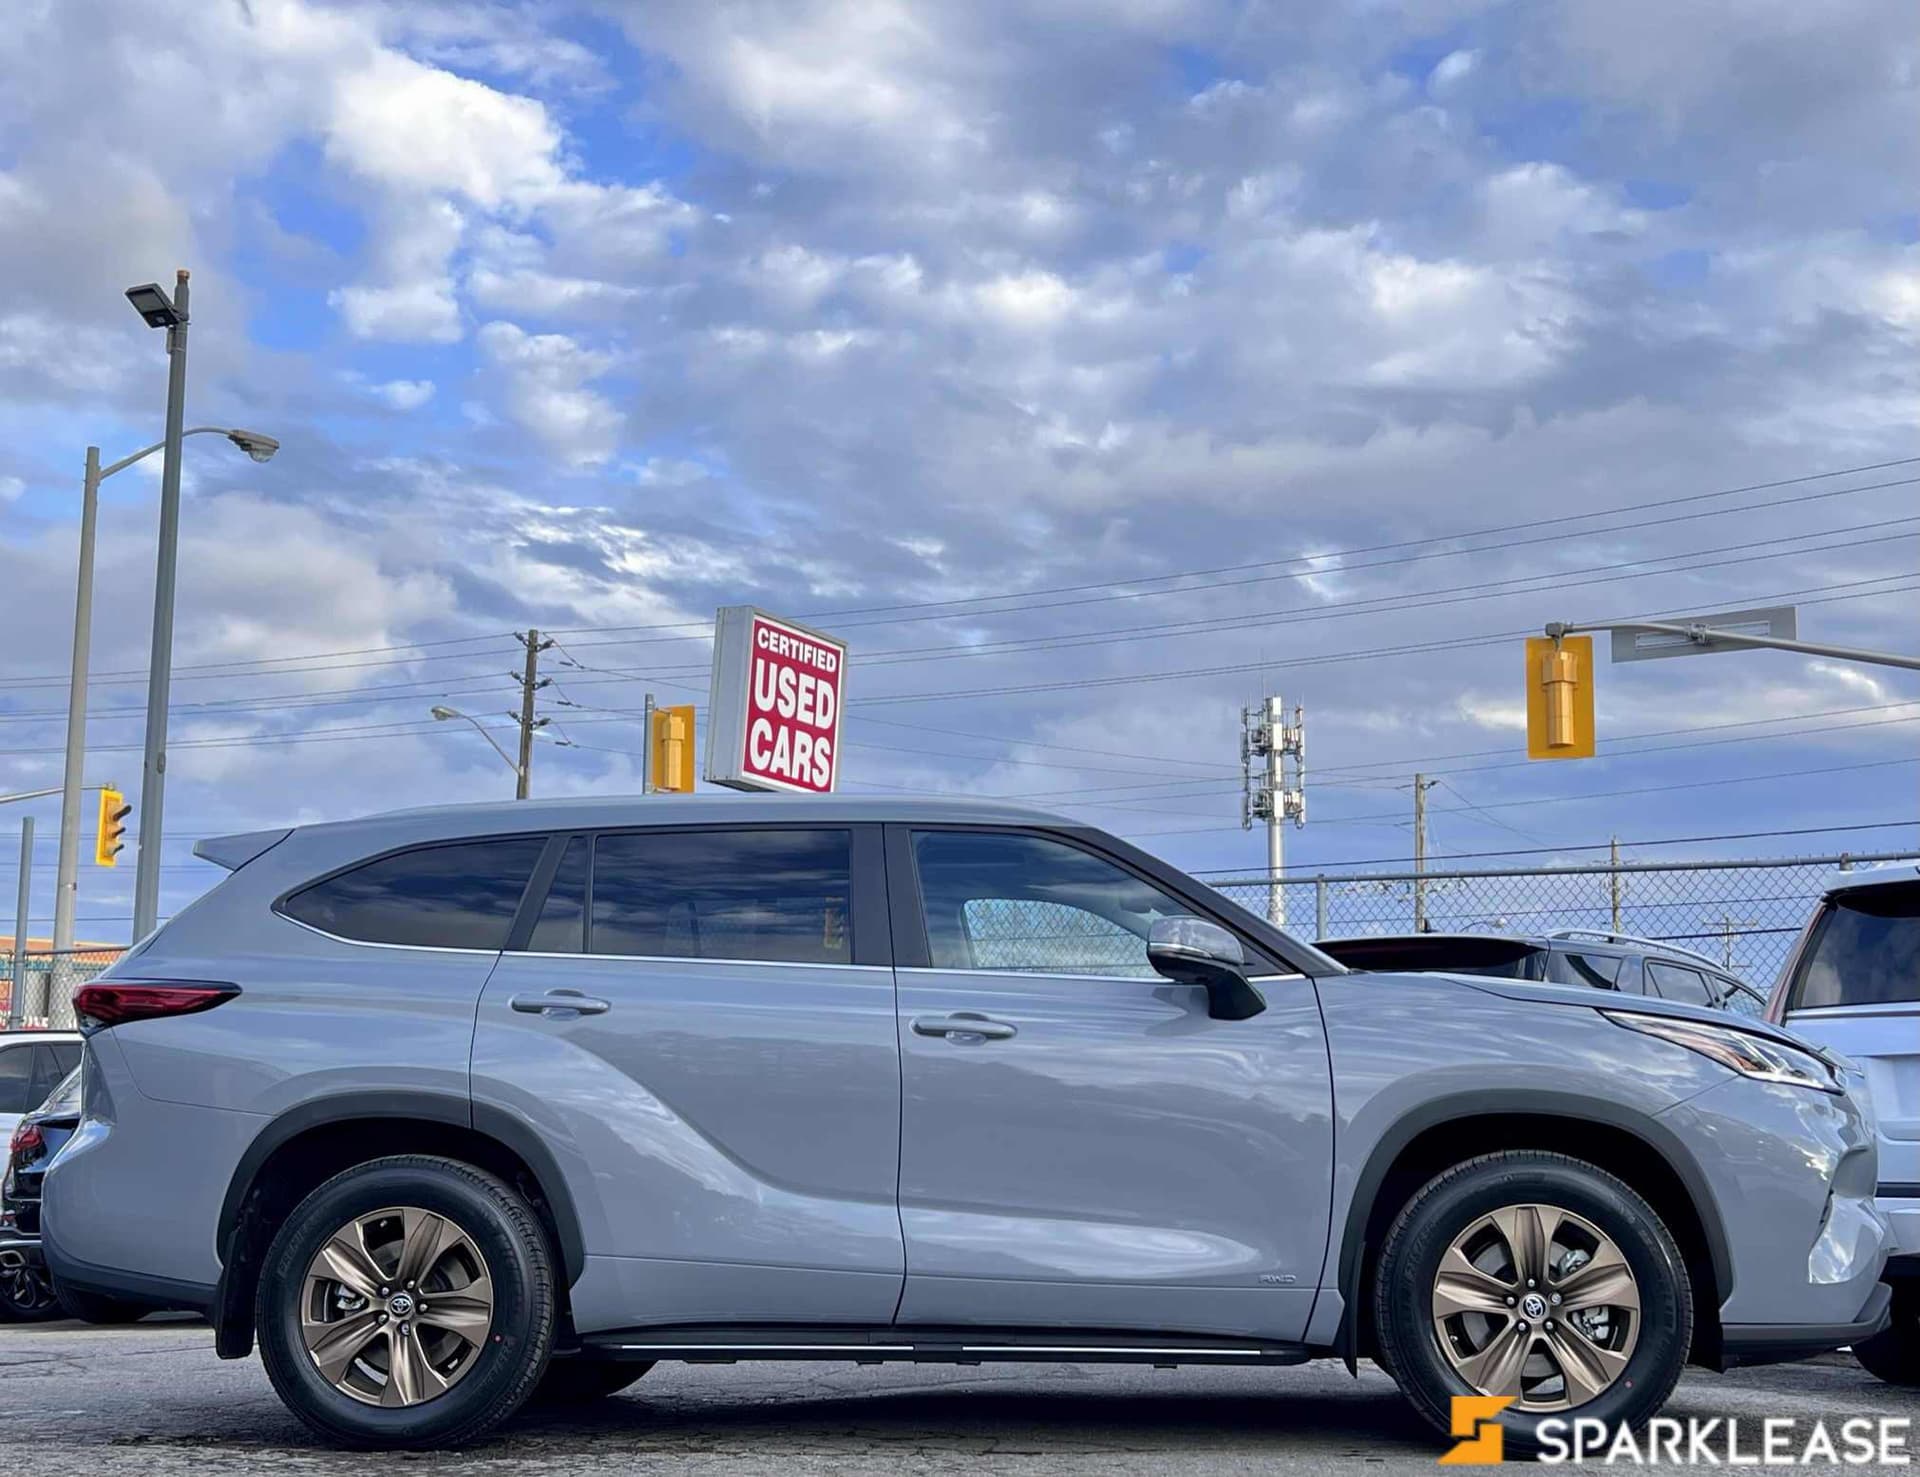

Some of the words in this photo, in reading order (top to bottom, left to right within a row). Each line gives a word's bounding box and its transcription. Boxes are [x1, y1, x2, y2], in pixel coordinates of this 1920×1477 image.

[757, 627, 837, 673] CERTIFIED
[754, 658, 835, 729] USED
[750, 718, 831, 787] CARS
